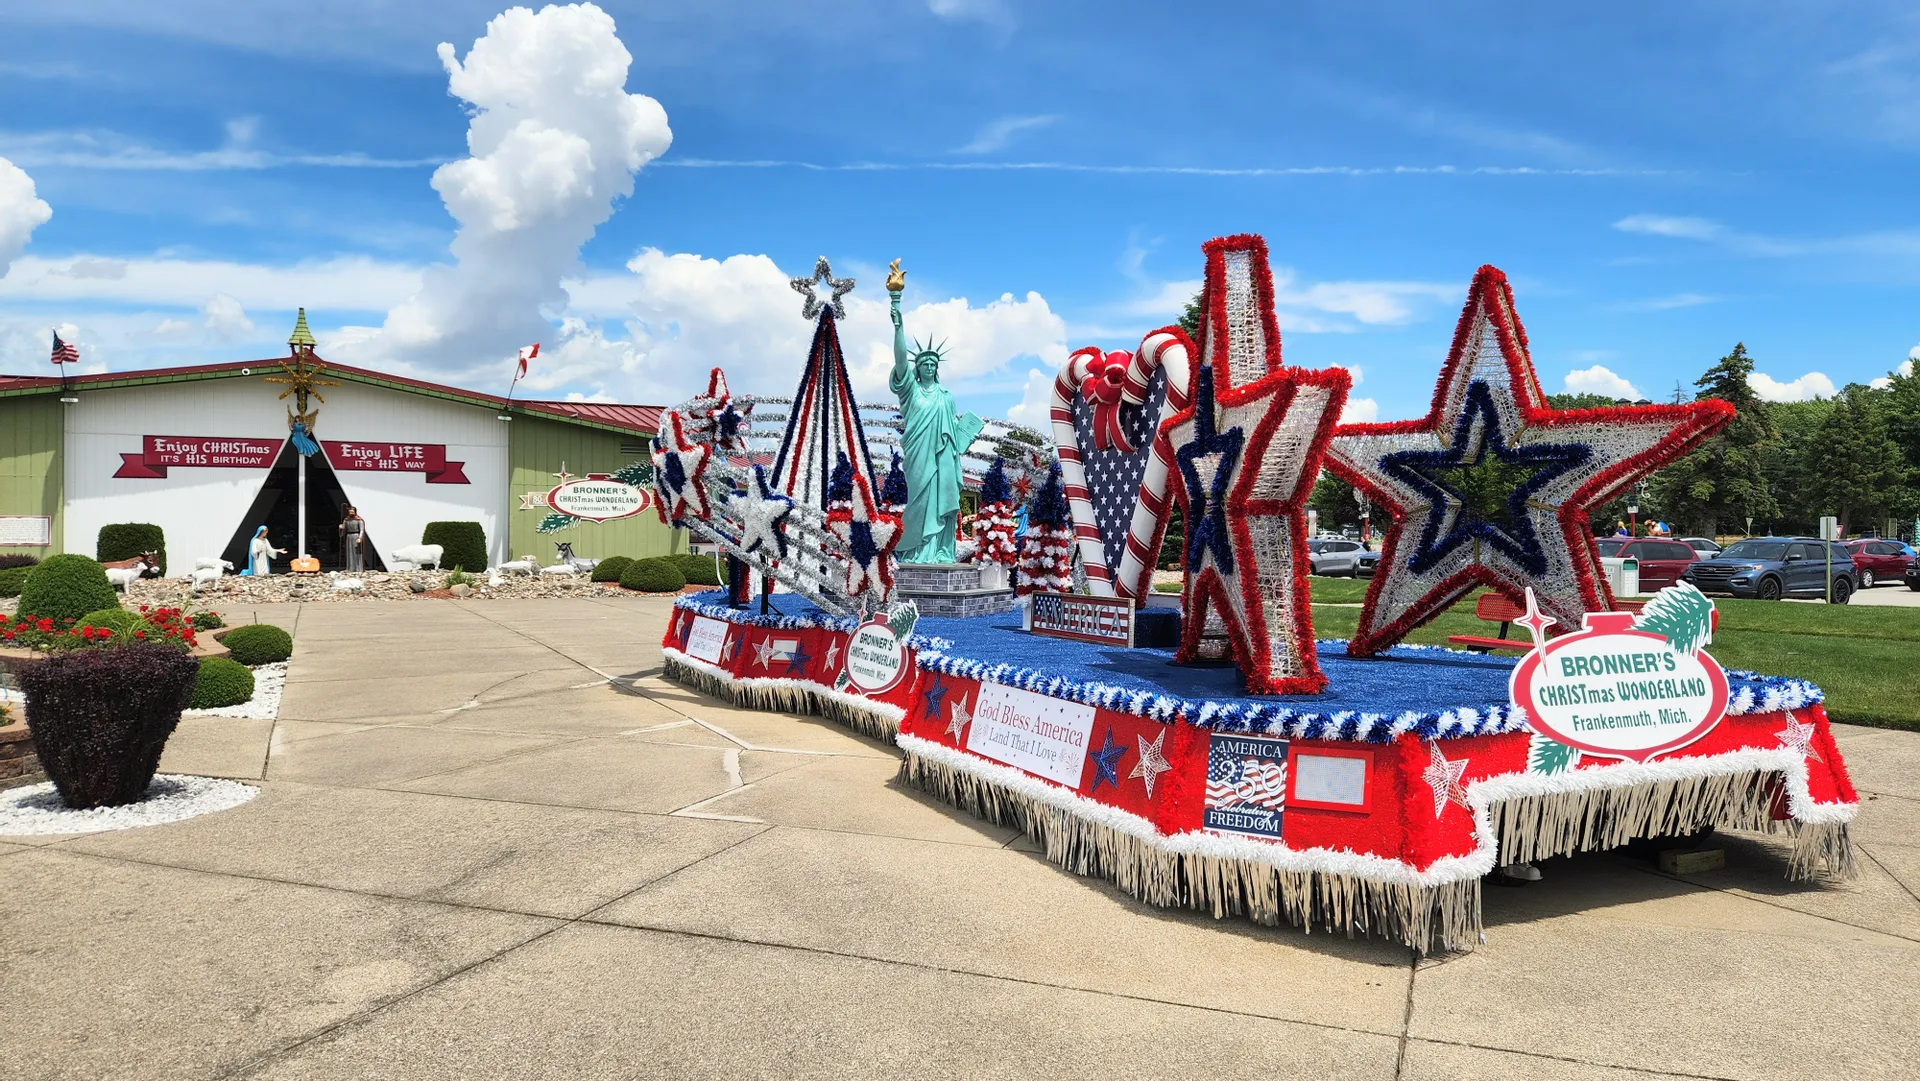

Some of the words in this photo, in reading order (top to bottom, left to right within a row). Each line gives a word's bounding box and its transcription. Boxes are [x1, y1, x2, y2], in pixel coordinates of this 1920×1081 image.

[154, 438, 198, 454] Enjoy
[202, 441, 270, 455] CHRISTmas
[340, 443, 381, 460] Enjoy
[389, 445, 424, 459] LIFE
[160, 455, 180, 463] IT'S
[185, 454, 208, 464] HIS
[212, 456, 263, 465] BIRTHDAY
[354, 460, 373, 468] IT'S
[378, 459, 399, 469] HIS
[405, 461, 426, 469] WAY
[559, 495, 594, 503] CHRISTmas
[595, 496, 638, 504] WONDERLAND
[1039, 600, 1124, 637] AMERICA
[859, 632, 894, 651] BRONNER'S
[869, 650, 899, 669] WONDERLAND
[1560, 651, 1676, 677] BRONNER'S
[1539, 683, 1616, 707] CHRISTmas
[1616, 677, 1706, 701] WONDERLAND
[978, 699, 1001, 721] God
[1001, 705, 1031, 731] Bless
[1031, 714, 1084, 748] America
[1572, 710, 1657, 732] Frankenmuth,
[1658, 708, 1692, 724] Mich.
[989, 727, 1010, 747] Land
[1011, 733, 1029, 755] That
[1030, 740, 1036, 755] I
[1036, 742, 1057, 762] Love
[1217, 740, 1282, 758] AMERICA
[1215, 759, 1284, 800] 250
[1209, 811, 1280, 833] FREEDOM
[1214, 798, 1275, 827] Celebrating
